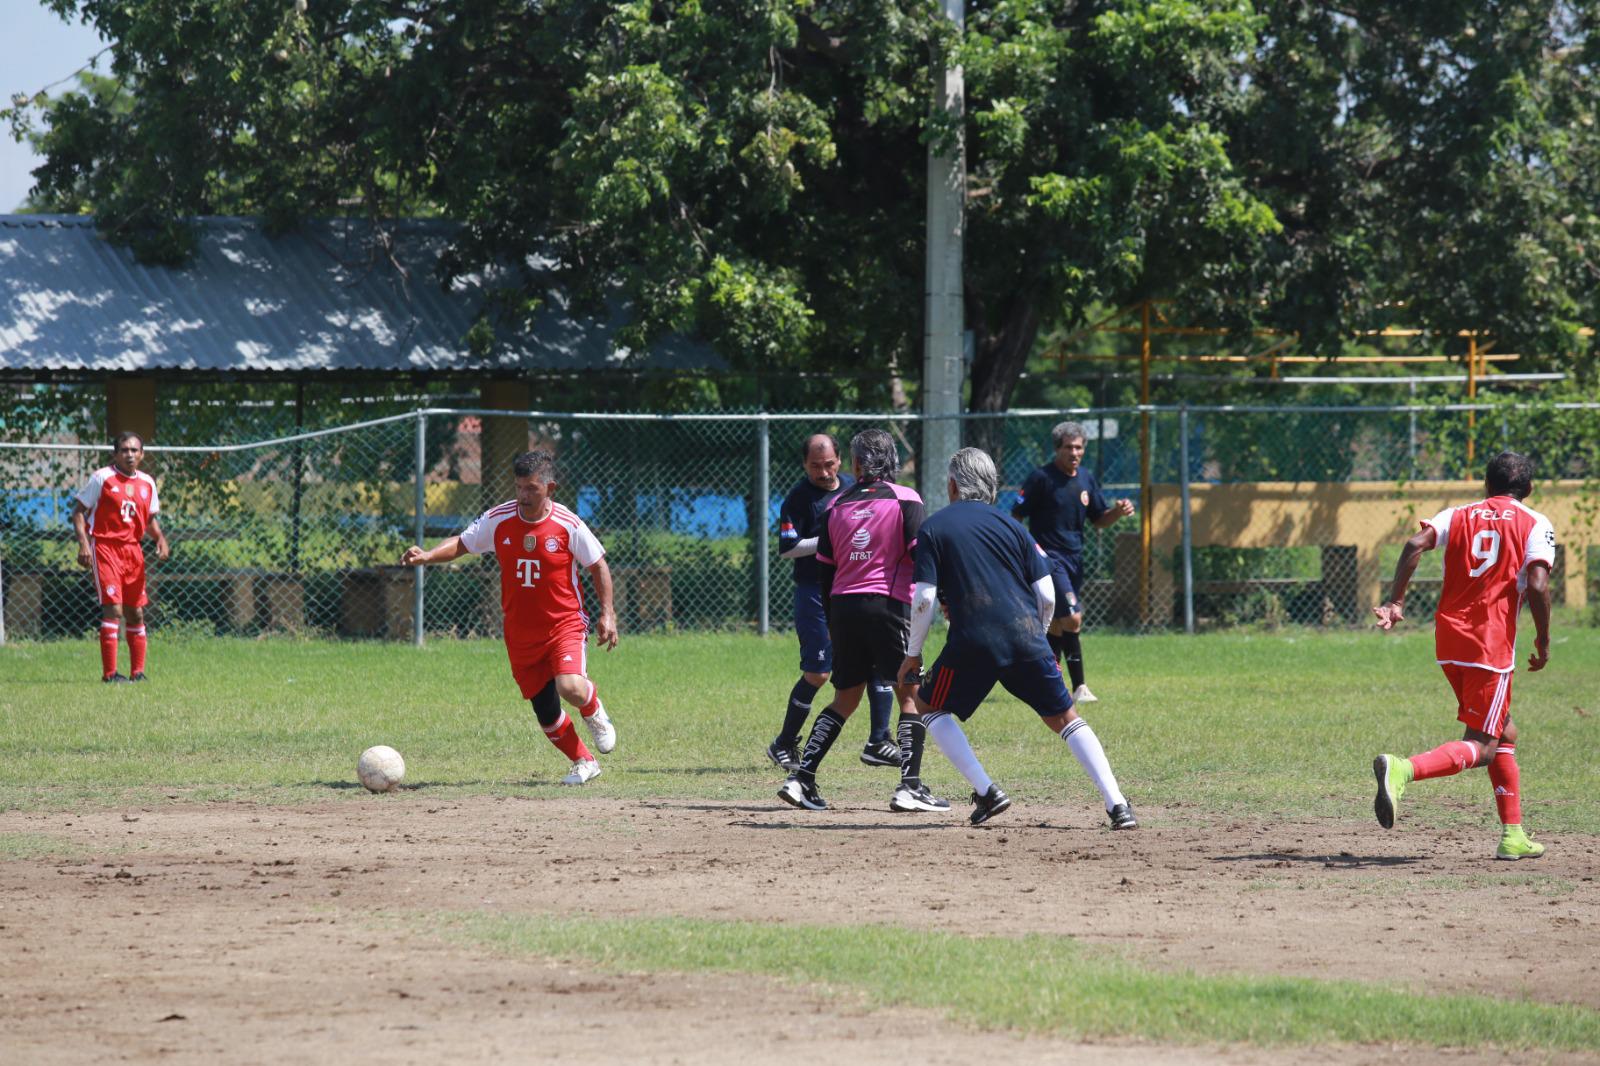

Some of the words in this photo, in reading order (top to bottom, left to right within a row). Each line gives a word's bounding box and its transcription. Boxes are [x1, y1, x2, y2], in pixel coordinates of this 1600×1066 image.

[1470, 508, 1516, 521] PELE
[849, 550, 873, 561] AT&T
[1469, 529, 1501, 578] 9
[516, 559, 541, 588] T
